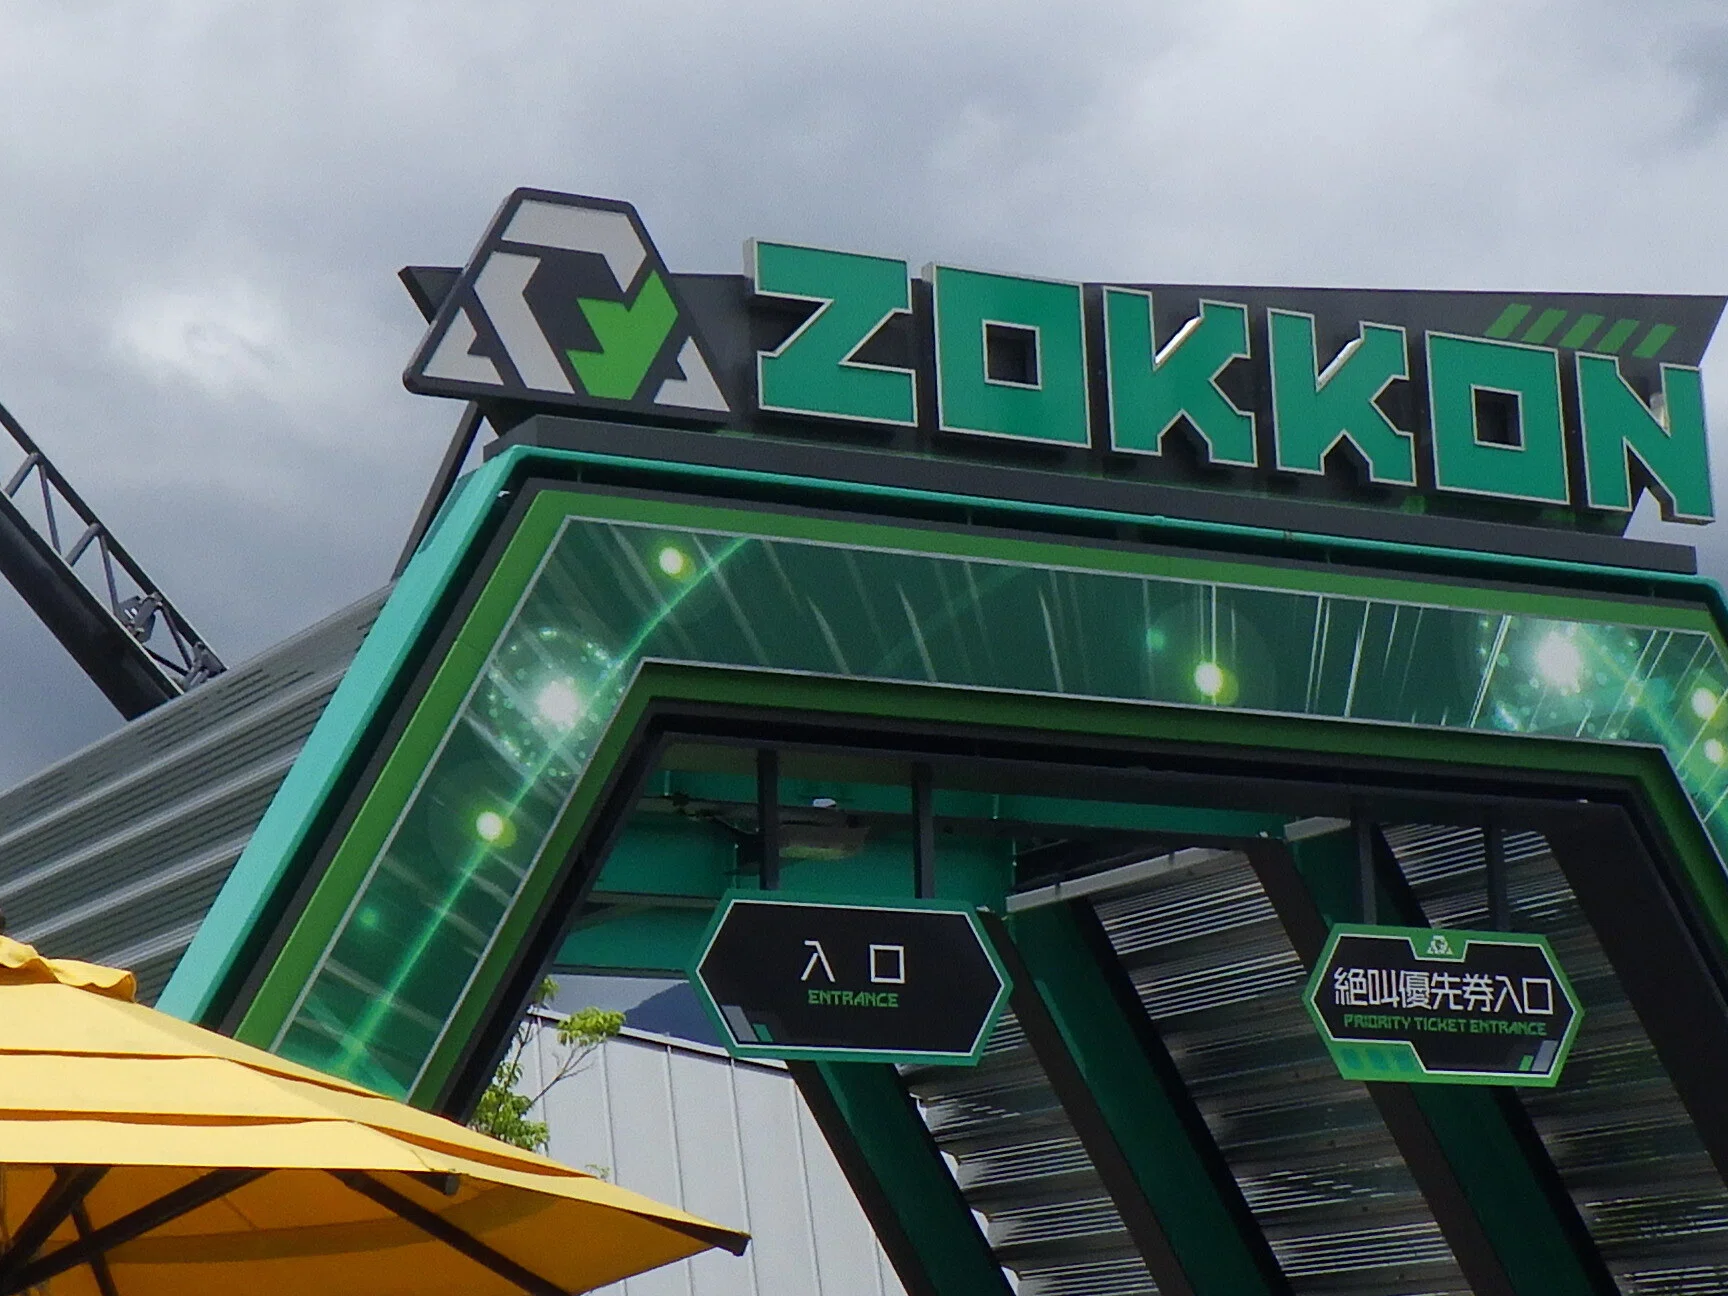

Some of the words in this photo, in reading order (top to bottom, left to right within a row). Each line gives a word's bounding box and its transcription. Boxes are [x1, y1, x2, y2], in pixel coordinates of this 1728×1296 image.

[744, 238, 1717, 526] ZOKKON
[807, 989, 900, 1008] ENTRANCE
[1333, 966, 1554, 1016] 絶叫優先券入口
[1343, 1014, 1409, 1030] PRIORITY
[1412, 1017, 1466, 1033] TICKET
[1469, 1020, 1548, 1036] ENTRANCE
